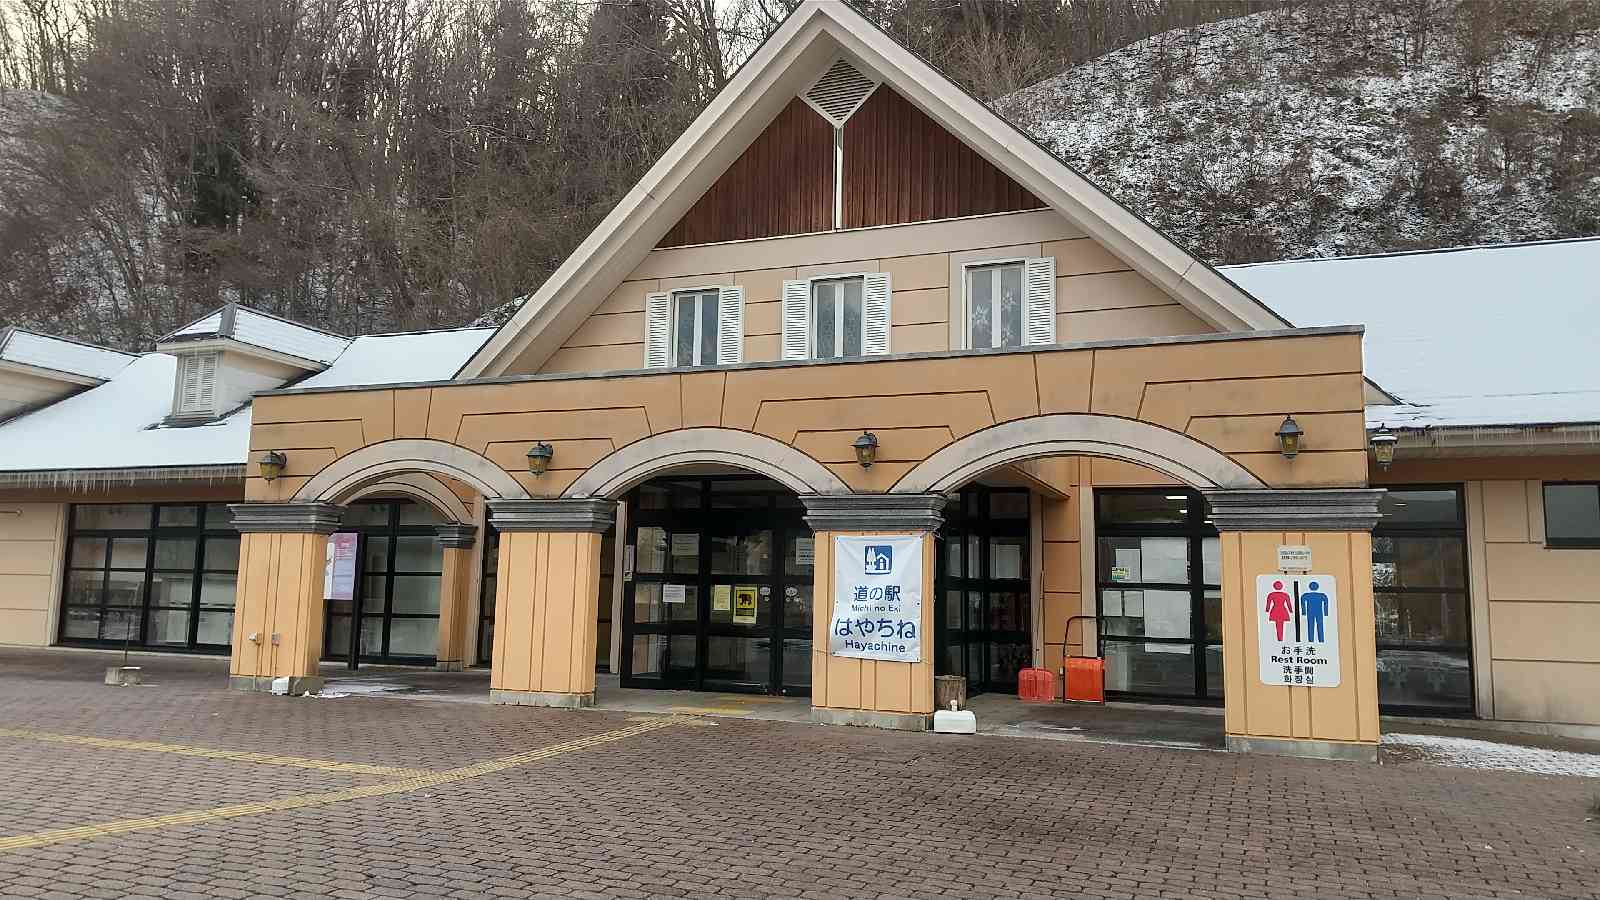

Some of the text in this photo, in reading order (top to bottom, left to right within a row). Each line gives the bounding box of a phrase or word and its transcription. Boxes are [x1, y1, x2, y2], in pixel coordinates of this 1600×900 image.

[853, 585, 901, 602] 道の駅
[834, 618, 916, 639] はやちね
[845, 640, 906, 653] Hayachine
[1281, 645, 1316, 656] お手洗
[1271, 655, 1328, 665] Rest Room
